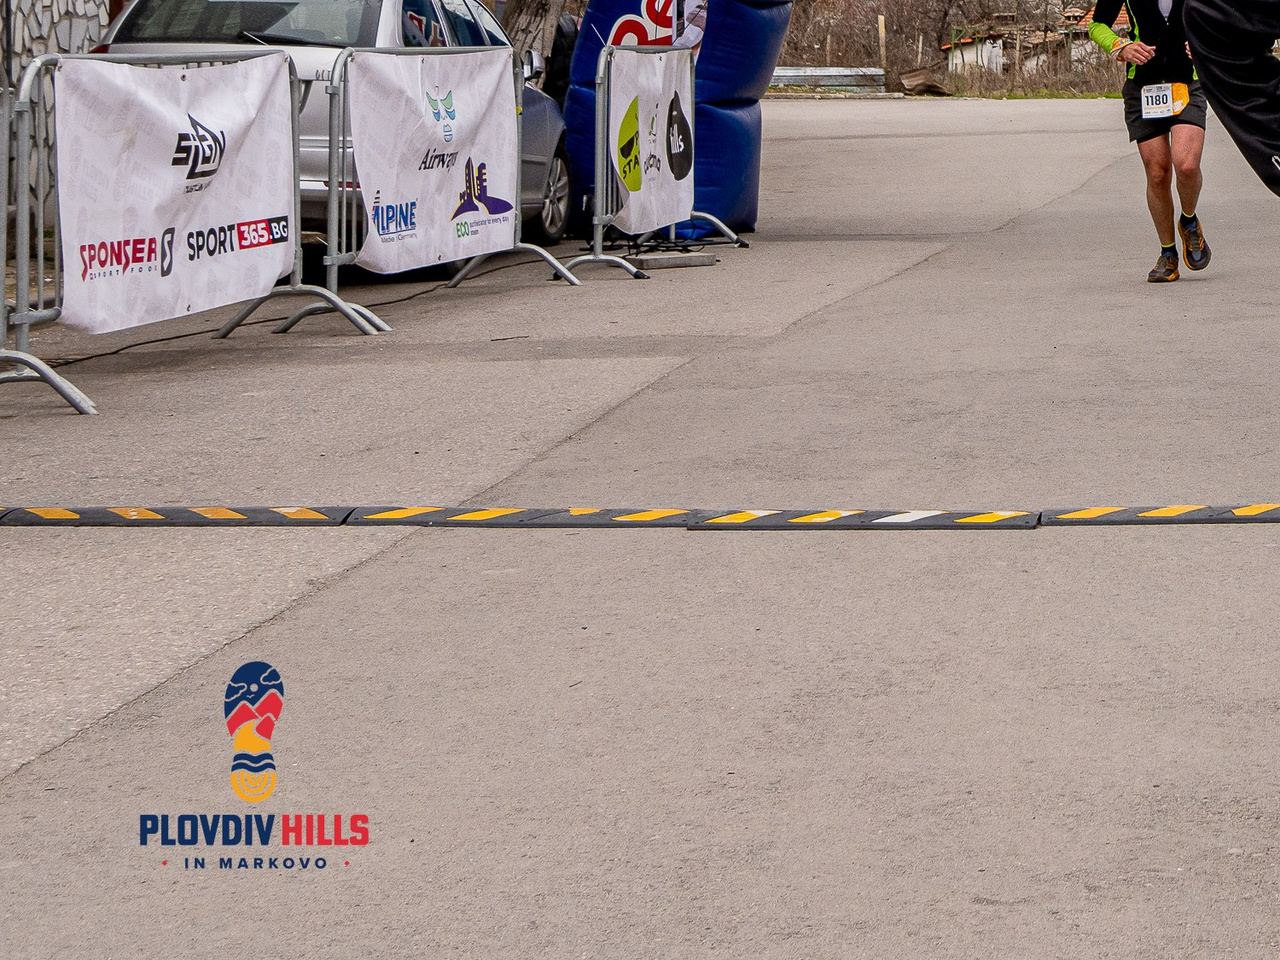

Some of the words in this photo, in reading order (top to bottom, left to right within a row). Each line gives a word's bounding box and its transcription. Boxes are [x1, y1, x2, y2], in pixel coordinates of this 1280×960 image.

[1145, 93, 1168, 106] 1180
[456, 220, 470, 238] ECO
[79, 236, 157, 282] SPONSER
